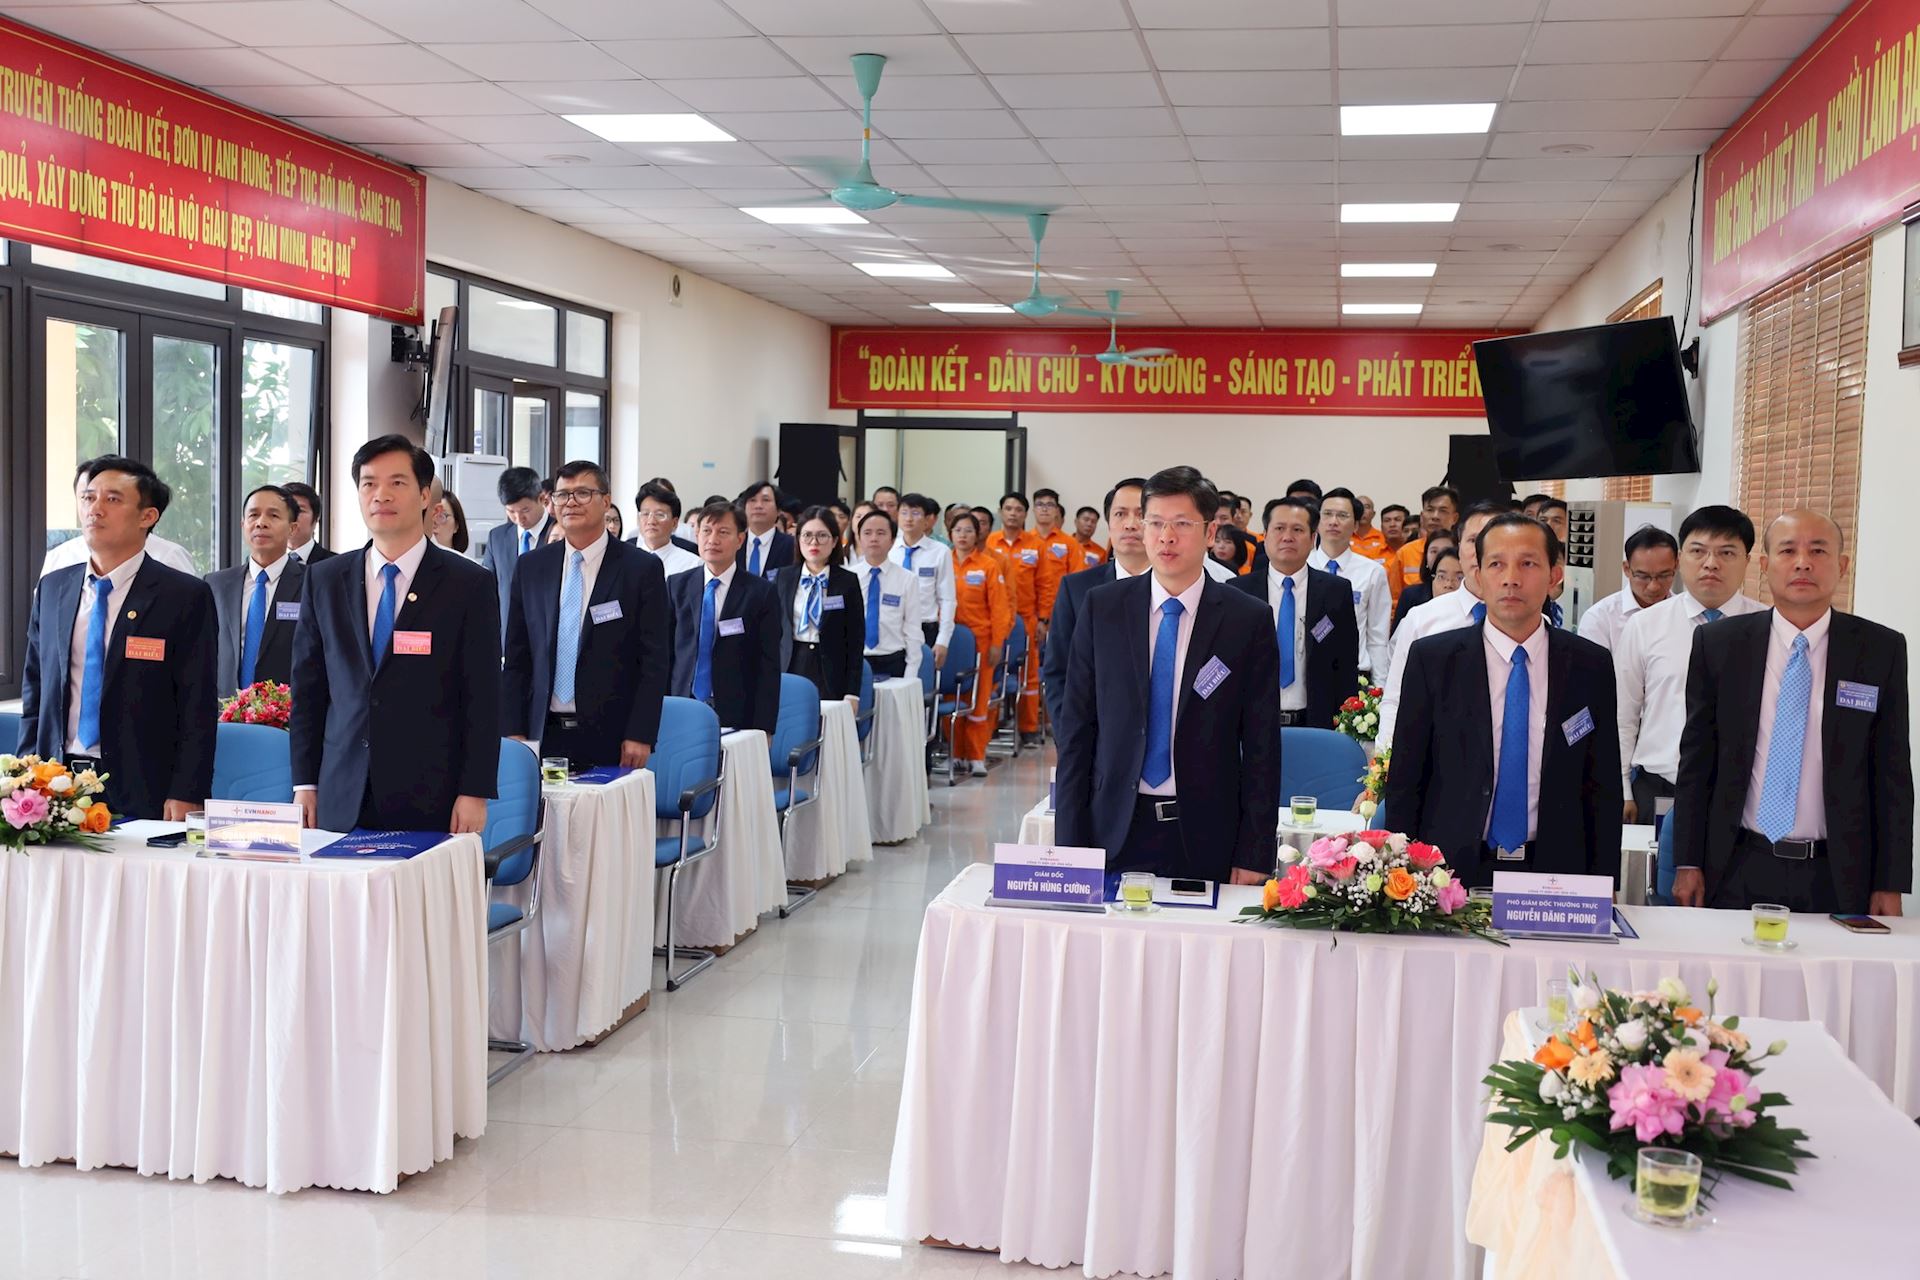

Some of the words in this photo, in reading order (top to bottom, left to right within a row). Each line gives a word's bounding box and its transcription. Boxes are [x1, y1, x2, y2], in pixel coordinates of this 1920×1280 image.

[57, 77, 103, 141] THỐNG
[106, 100, 143, 153] ĐOÀN
[146, 105, 171, 167] KẾT,
[174, 124, 199, 170] ĐƠN
[202, 133, 213, 183] VỊ
[215, 139, 238, 182] ANH
[241, 141, 273, 197] HÙNG;
[275, 151, 297, 199] TIẾP
[300, 166, 318, 213] TỤC
[320, 162, 336, 212] ĐỔI
[338, 176, 358, 222] MỚI,
[360, 183, 383, 227] SÁNG
[385, 196, 403, 237] TẠO,
[1753, 130, 1774, 237] SẢN
[1772, 121, 1794, 237] VIỆT
[1792, 112, 1818, 210] NAM
[1824, 55, 1863, 187] NGƯỜI
[1862, 38, 1901, 161] LÃNH
[37, 154, 66, 209] XÂY
[69, 169, 107, 224] DỰNG
[111, 172, 136, 227] THỦ
[138, 183, 156, 232] ĐÔ
[159, 187, 175, 236] HÀ
[178, 193, 199, 250] NỘI
[202, 200, 228, 249] GIÀU
[231, 212, 254, 261] ĐẸP,
[256, 214, 277, 260] VĂN
[280, 226, 309, 272] MINH,
[311, 230, 333, 280] HIỆN
[931, 344, 969, 392] KẾT
[974, 372, 983, 381] -
[988, 349, 1032, 392] DÂN
[1037, 345, 1080, 394] CHỦ
[1086, 373, 1094, 382] -
[1134, 353, 1207, 394] CƯƠNG
[1213, 374, 1222, 383] -
[1228, 351, 1288, 395] SÁNG
[1294, 358, 1336, 404] TẠO
[1342, 375, 1350, 384] -
[1357, 351, 1415, 396] PHÁT
[1007, 877, 1039, 892] NGUYỄN
[1040, 878, 1062, 893] HÙNG
[1063, 881, 1091, 895] CƯỜNG
[1034, 870, 1050, 878] GIÁM
[1050, 870, 1065, 879] ĐỐC
[1506, 907, 1540, 921] NGUYỄN
[1542, 910, 1566, 923] ĐĂNG
[1567, 912, 1597, 925] PHONG
[1521, 899, 1538, 907] GIÁM
[1538, 899, 1552, 907] ĐỐC
[1553, 900, 1581, 908] THƯỜNG
[1581, 902, 1599, 910] TRỰC
